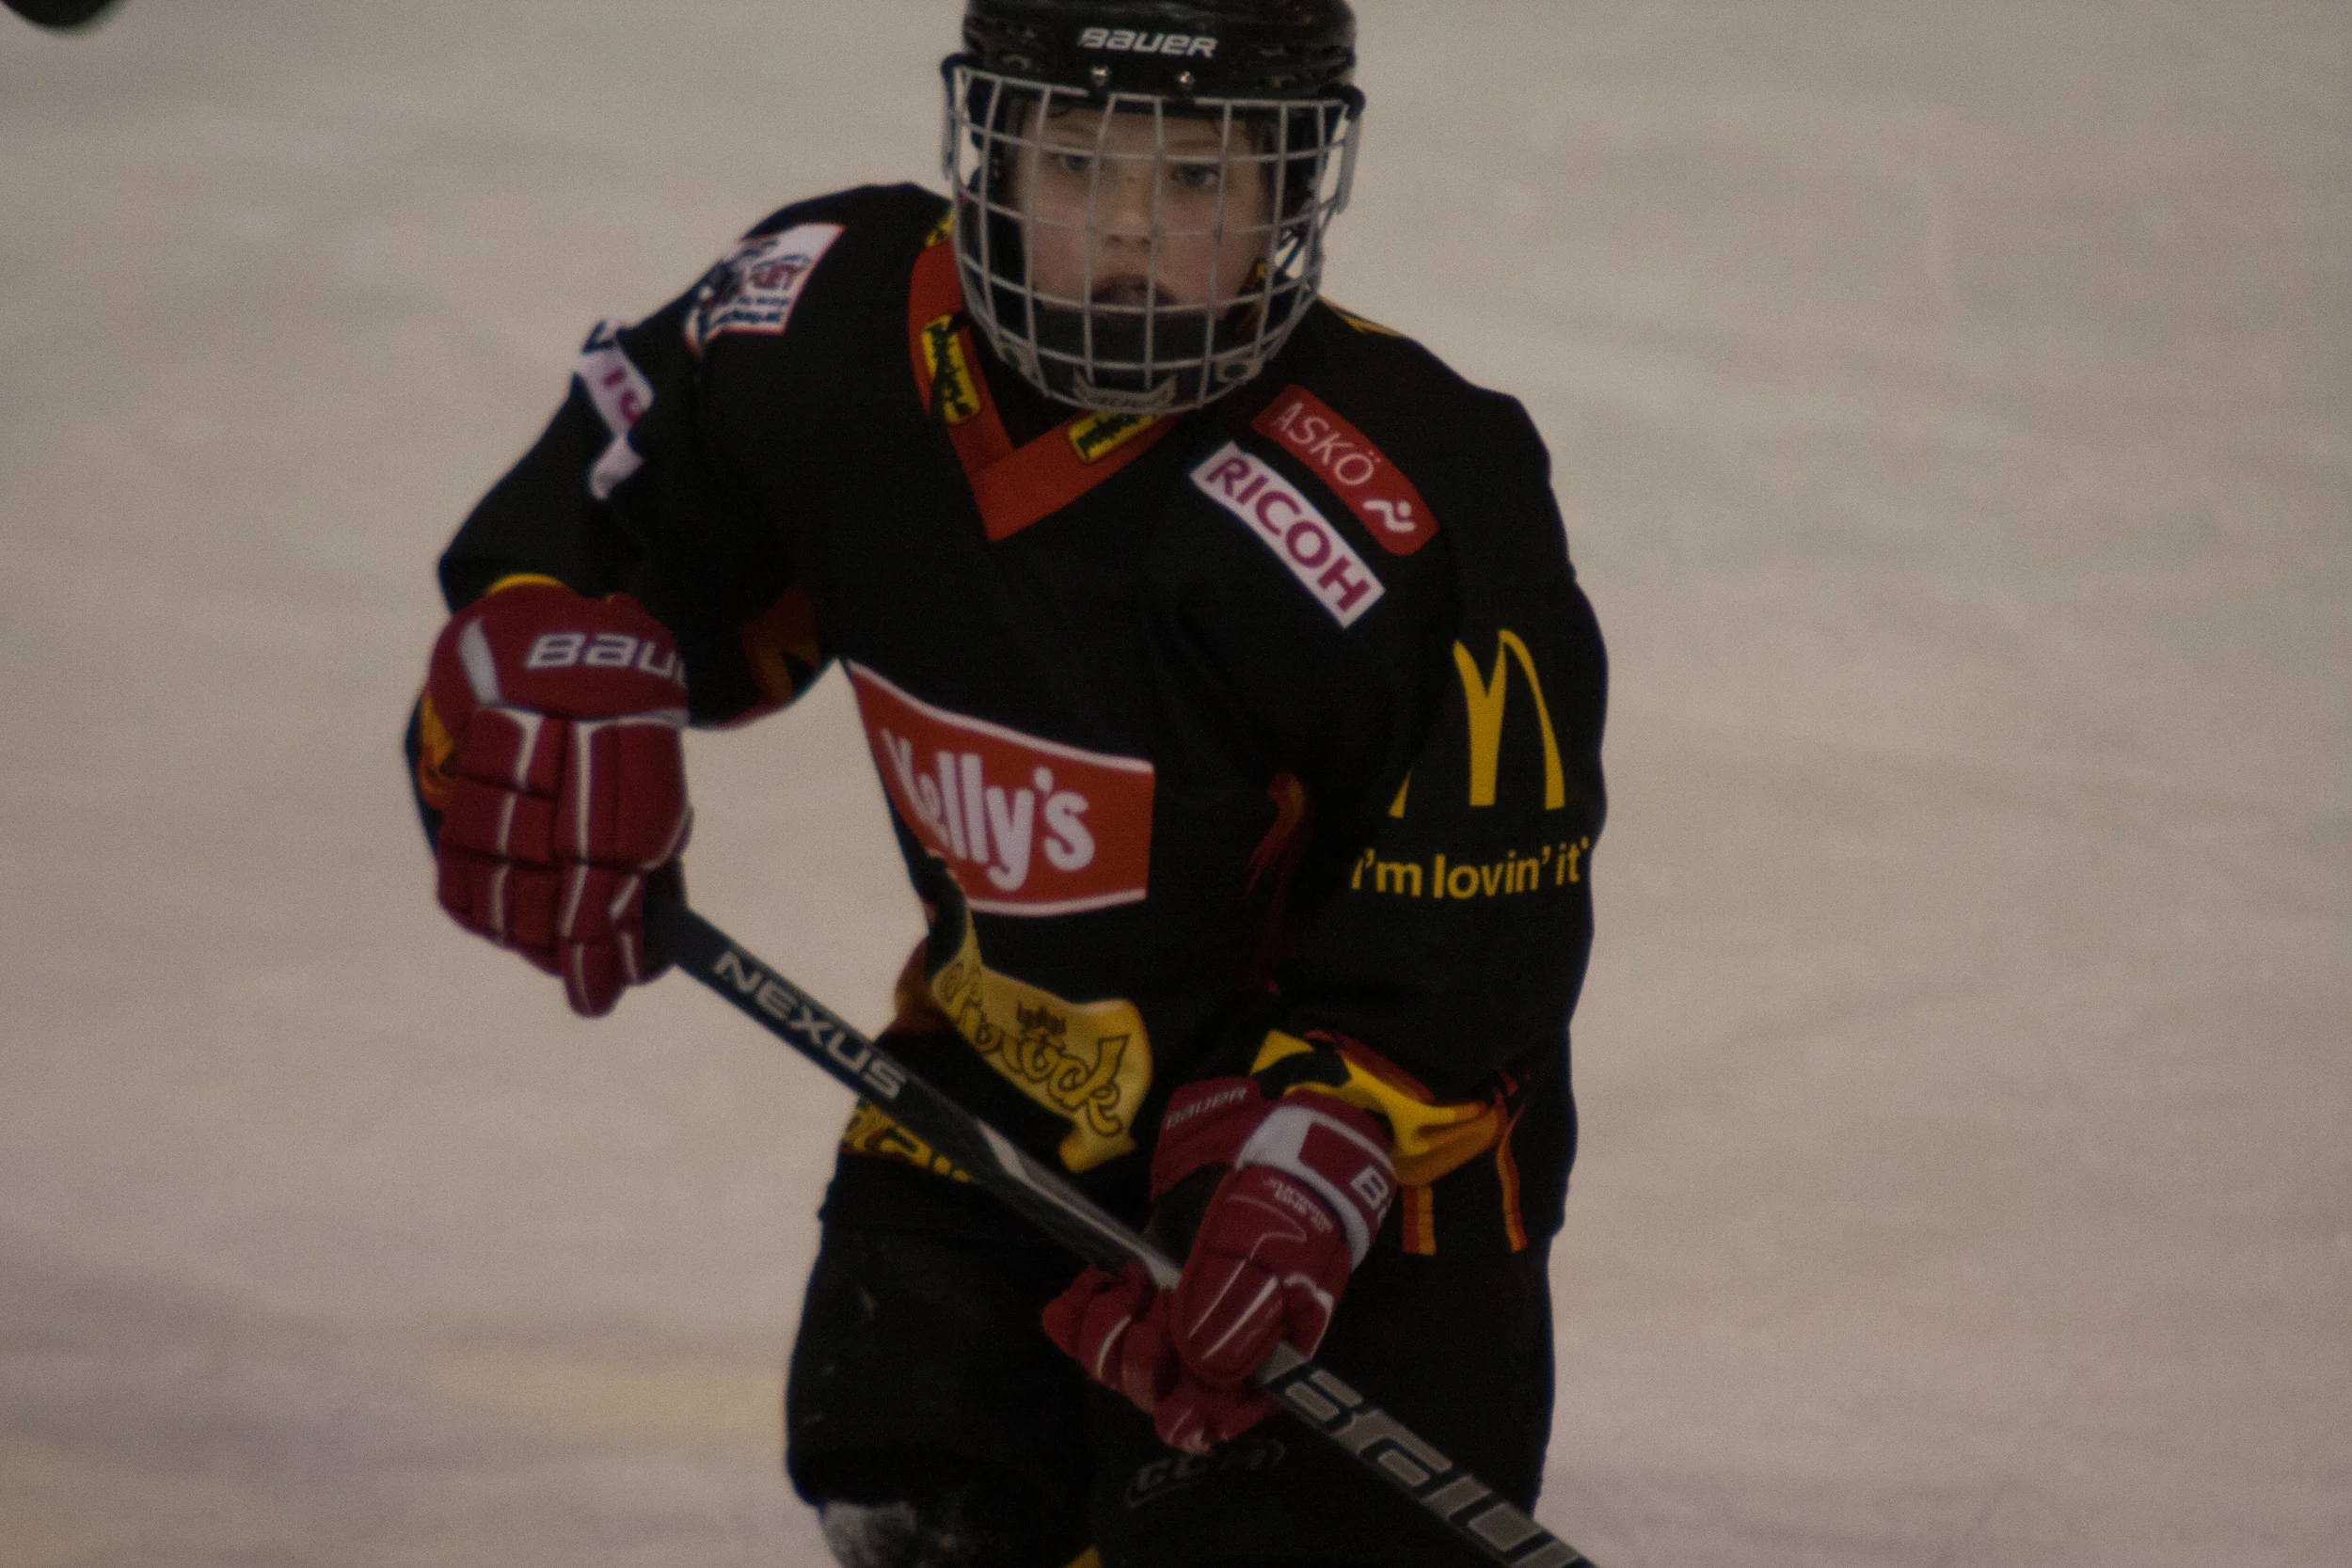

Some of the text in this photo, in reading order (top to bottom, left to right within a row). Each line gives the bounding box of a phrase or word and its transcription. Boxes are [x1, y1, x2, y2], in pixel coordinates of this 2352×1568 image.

[1077, 26, 1219, 59] BAUER
[1275, 402, 1381, 485] ASKÖ
[1206, 457, 1370, 612] RICOH
[1432, 843, 1551, 900] lovin'
[713, 950, 908, 1101] NEXUS
